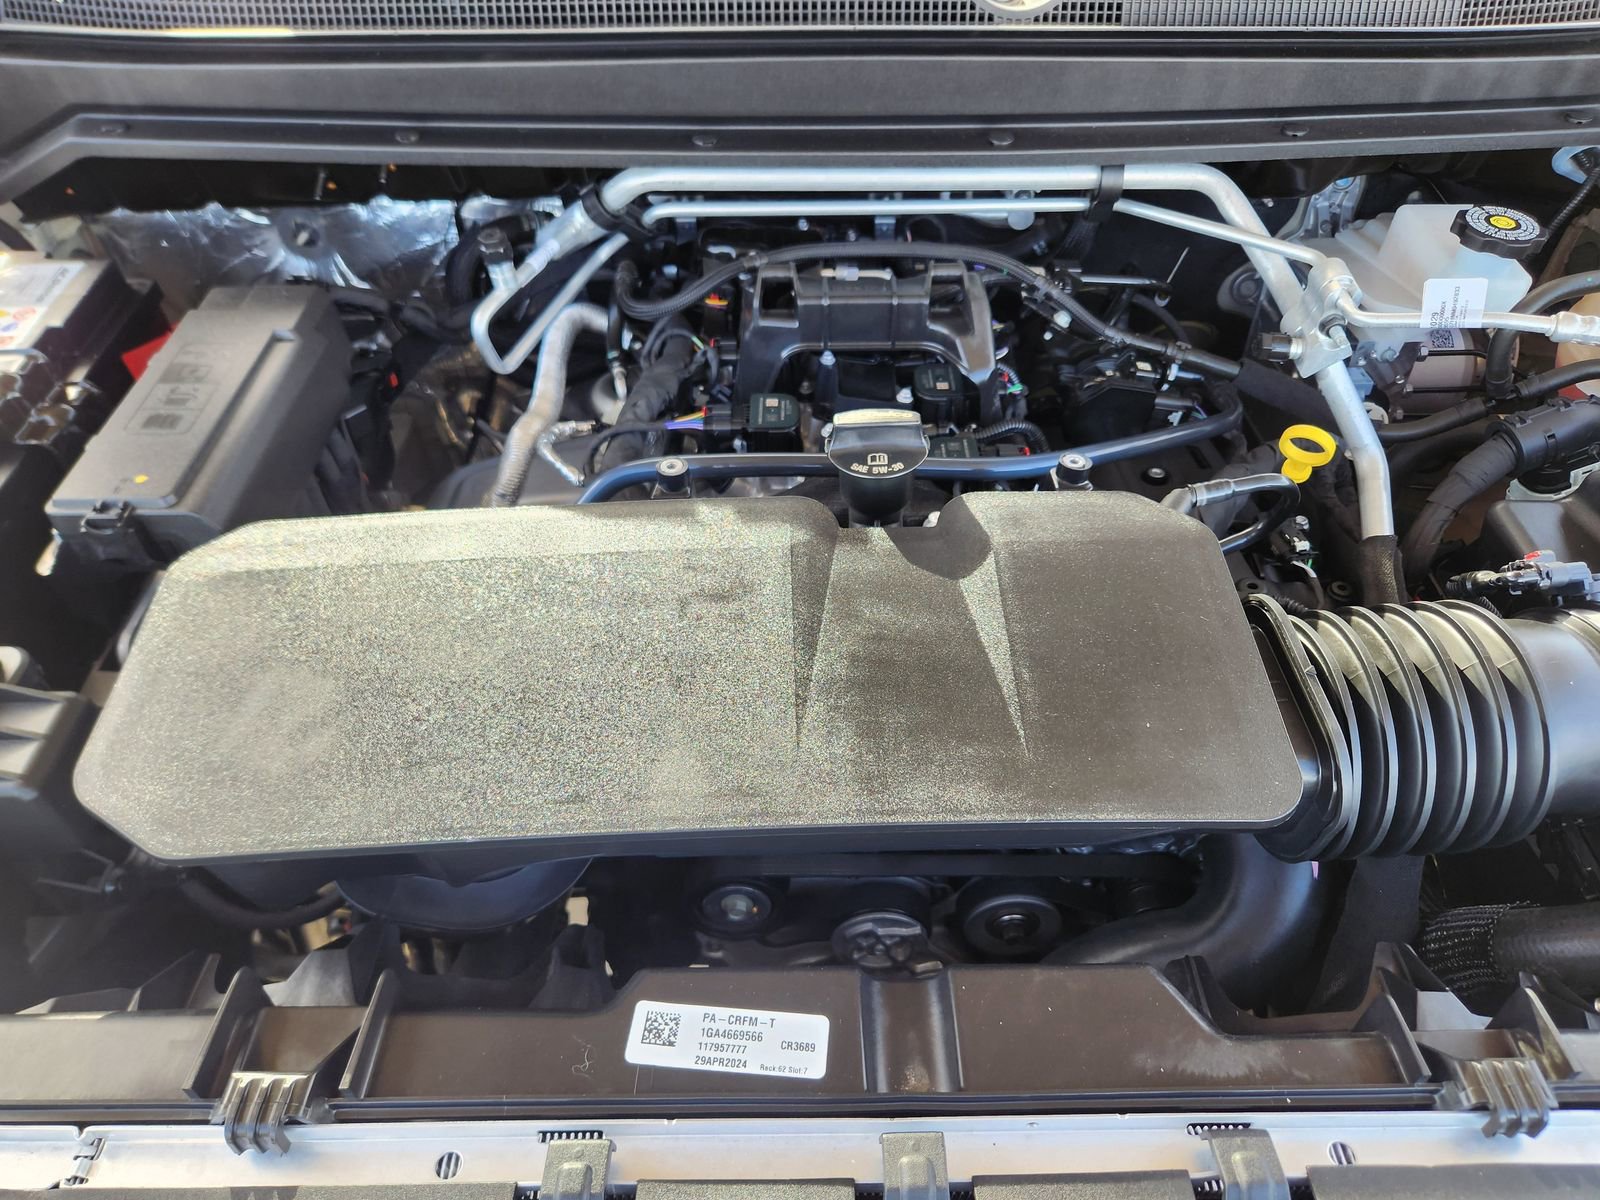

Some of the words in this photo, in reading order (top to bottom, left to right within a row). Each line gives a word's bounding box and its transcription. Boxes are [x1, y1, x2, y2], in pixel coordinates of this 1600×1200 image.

[850, 462, 869, 473] SAE
[872, 462, 904, 474] 5W-30
[702, 1012, 776, 1028] PA-CRFM-T
[701, 1027, 763, 1042] 1GA4669566
[698, 1042, 747, 1054] 117957777
[780, 1040, 816, 1053] CR3689
[694, 1055, 748, 1069] 29APR2024
